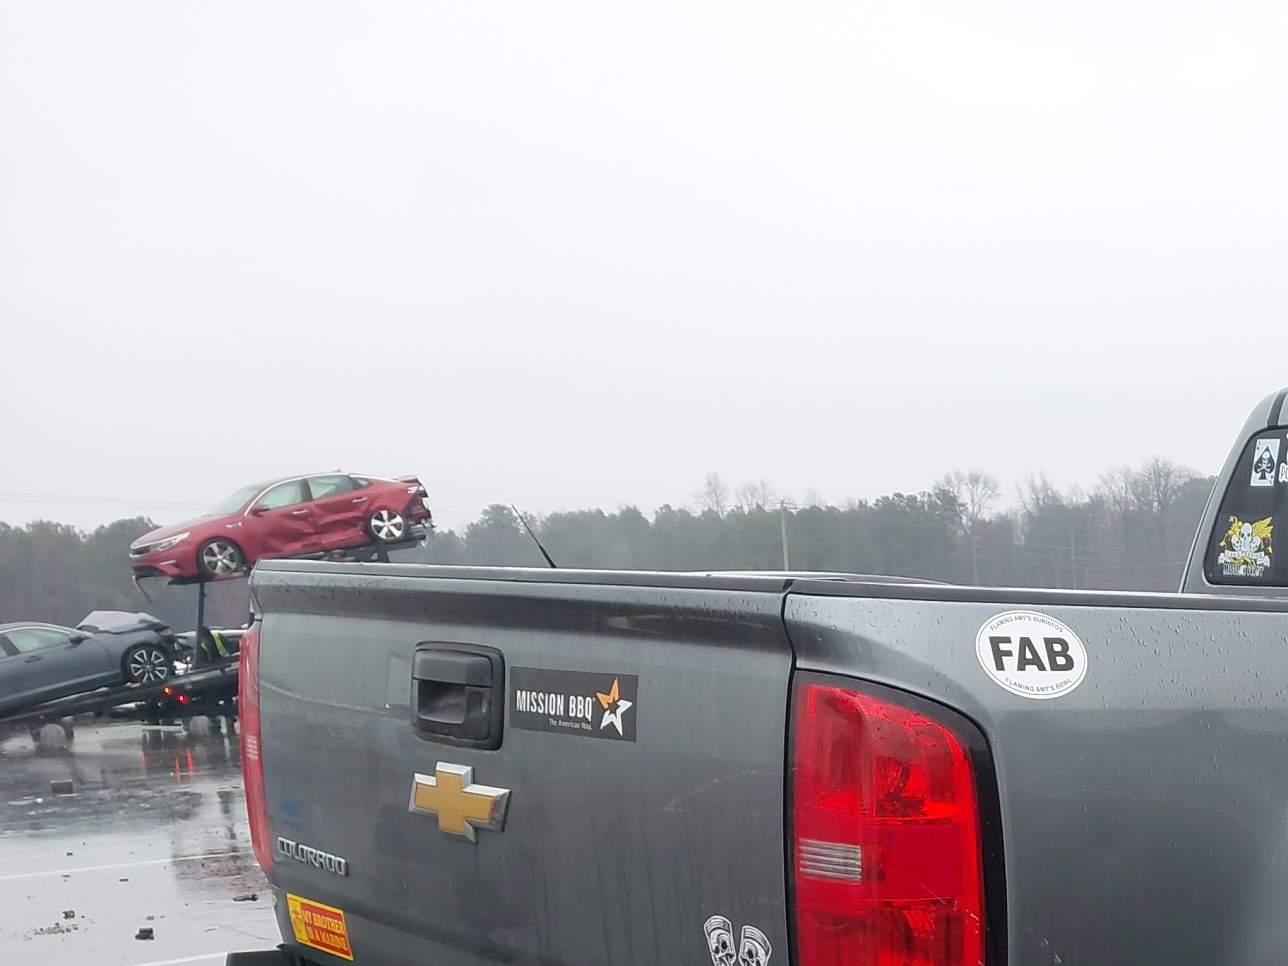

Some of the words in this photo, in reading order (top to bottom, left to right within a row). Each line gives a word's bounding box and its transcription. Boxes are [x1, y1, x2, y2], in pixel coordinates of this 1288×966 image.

[990, 616, 1014, 632] FLAMING
[988, 636, 1075, 672] FAB
[516, 690, 565, 716] MISSION
[569, 695, 594, 721] BBQ
[549, 717, 557, 727] The
[557, 719, 580, 729] American
[277, 836, 346, 876] COLORADO
